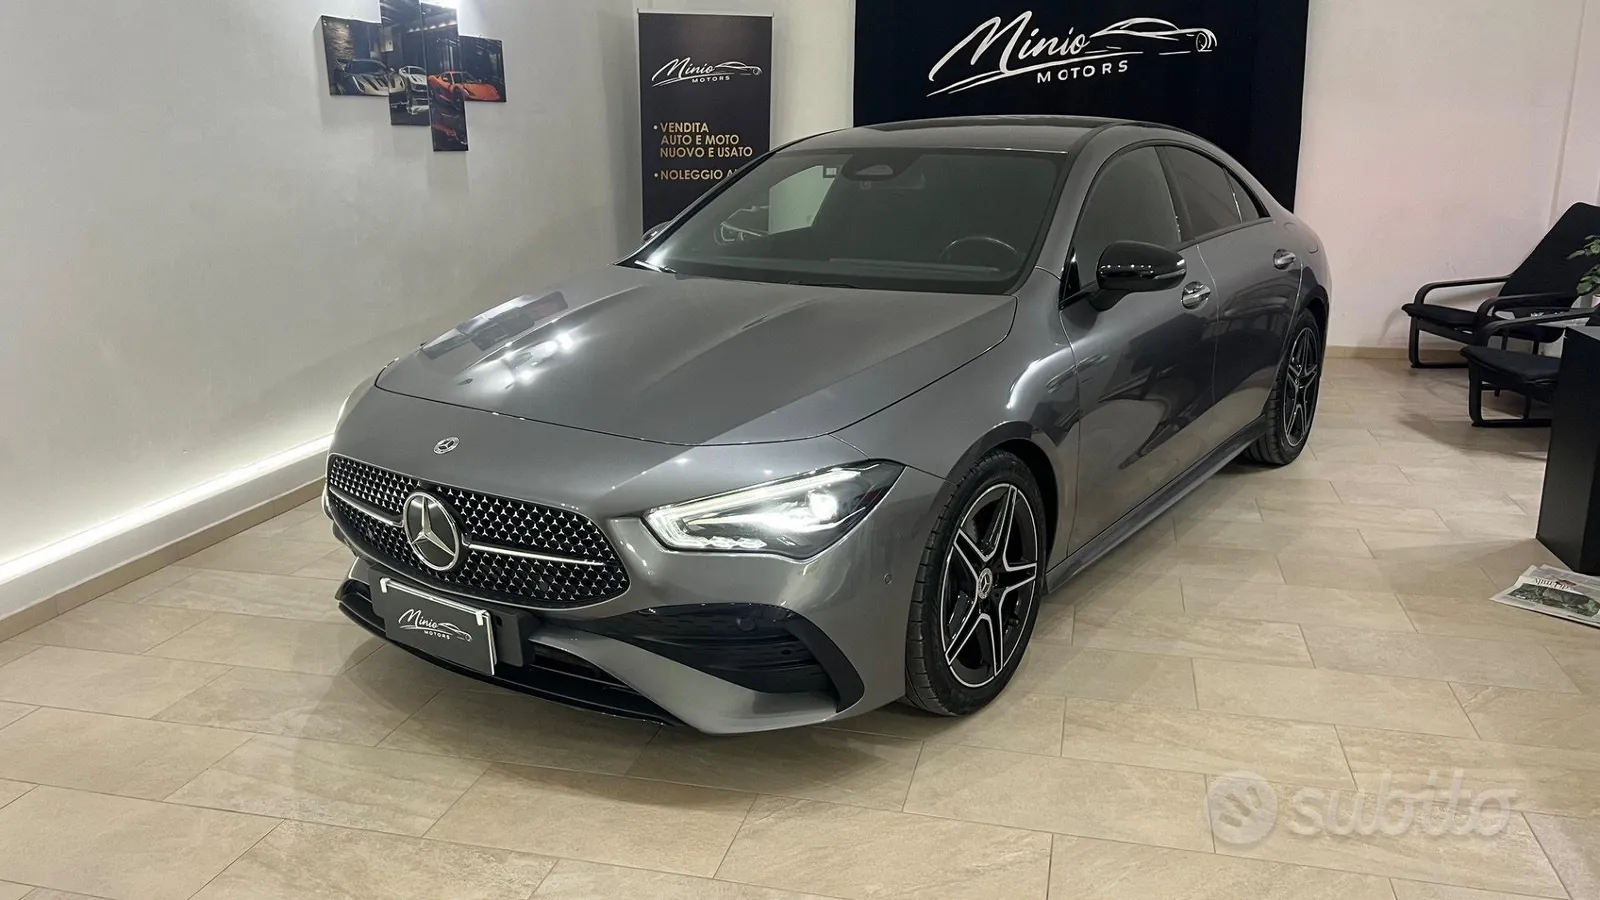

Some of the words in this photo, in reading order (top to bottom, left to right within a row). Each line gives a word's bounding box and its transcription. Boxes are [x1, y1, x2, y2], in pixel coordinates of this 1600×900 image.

[928, 10, 1091, 81] Minio
[651, 57, 716, 81] Minio
[1036, 60, 1129, 83] MOTORS
[691, 75, 731, 83] MOTORS
[660, 122, 709, 133] VENDITA
[660, 135, 692, 145] AUTO
[695, 135, 702, 145] E
[705, 134, 739, 145] MOTO
[660, 147, 705, 158] NUOVO
[708, 147, 714, 157] E
[717, 146, 753, 157] USATO
[660, 169, 723, 180] NOLEGGIO
[398, 608, 439, 629] Minio
[423, 630, 451, 640] MOTORS
